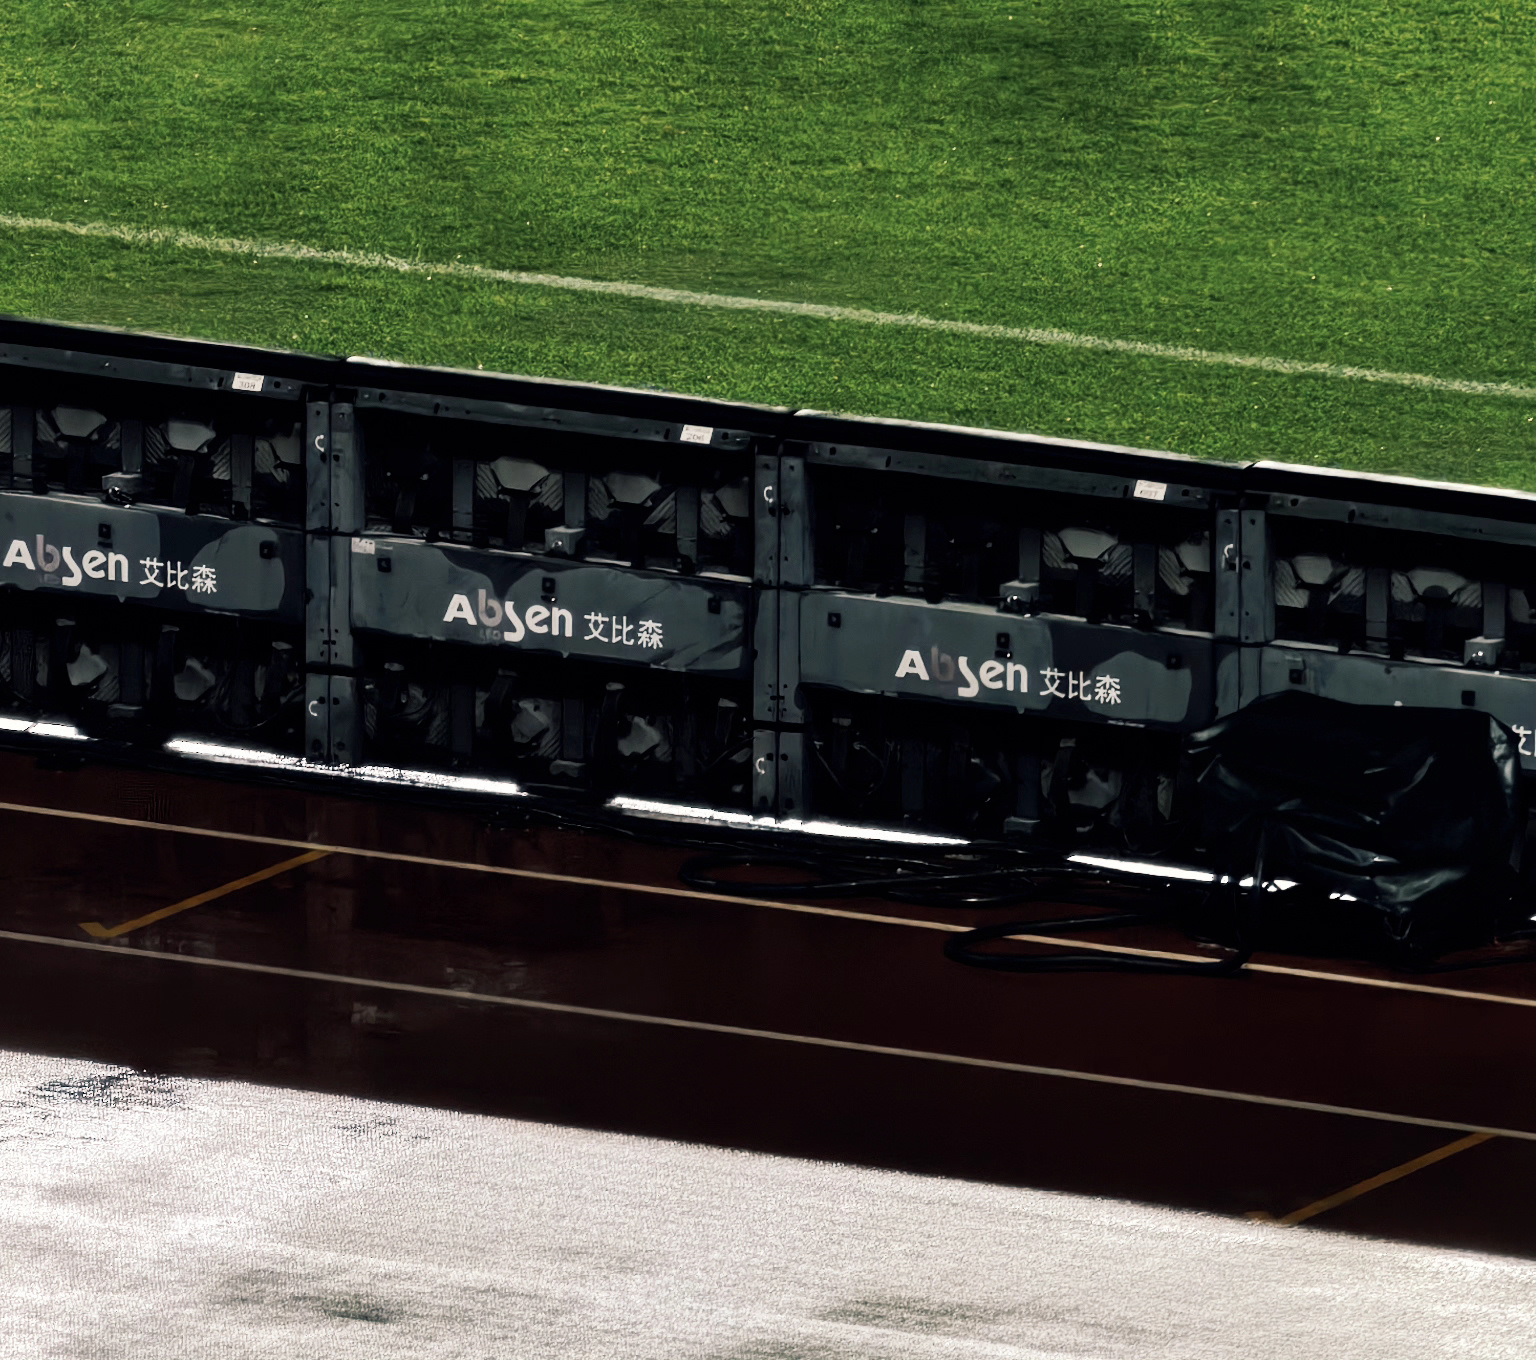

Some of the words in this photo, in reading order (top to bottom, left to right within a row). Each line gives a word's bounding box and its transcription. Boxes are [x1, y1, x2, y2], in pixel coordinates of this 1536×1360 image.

[2, 534, 129, 587] Absen
[139, 556, 217, 594] 艾比森
[443, 588, 573, 642] Absen
[583, 611, 664, 649] 艾比森
[1039, 666, 1122, 705] 艾比森
